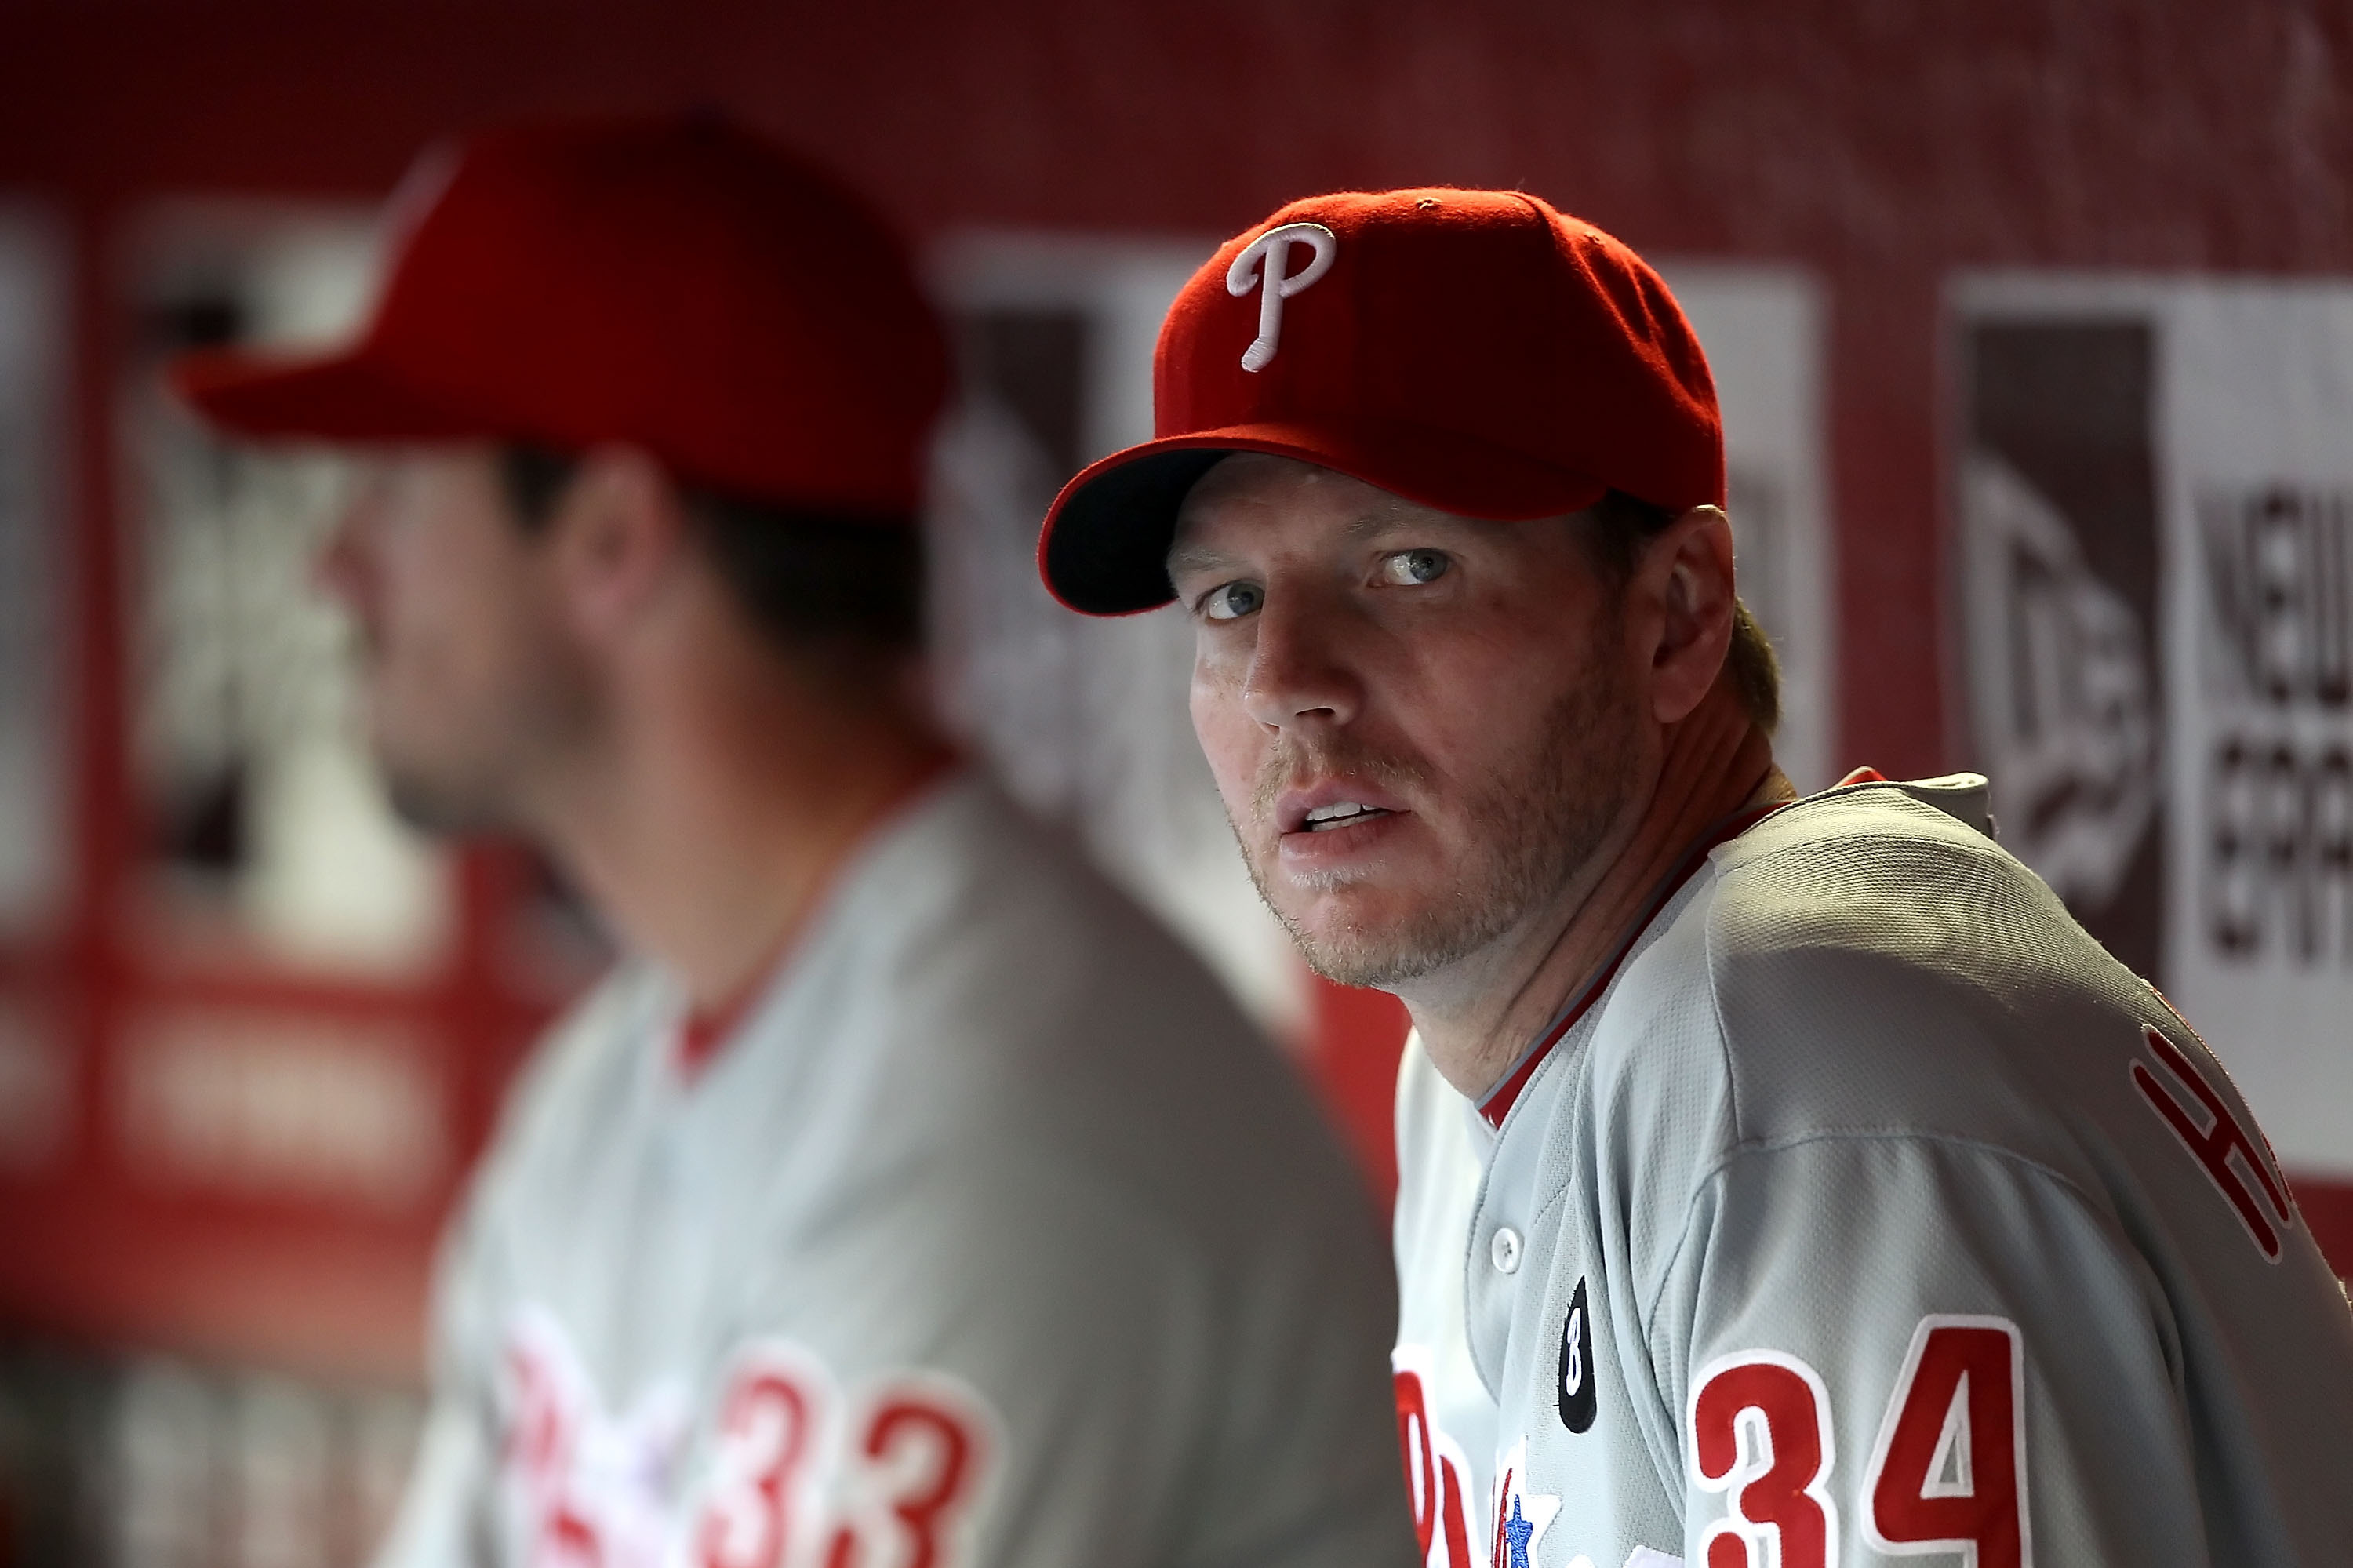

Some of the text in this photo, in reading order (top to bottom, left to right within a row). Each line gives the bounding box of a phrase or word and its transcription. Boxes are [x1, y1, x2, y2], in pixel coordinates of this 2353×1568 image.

[1226, 221, 1337, 373] P
[1565, 1306, 1584, 1397] 8
[1688, 1314, 2033, 1568] 34
[694, 1343, 998, 1568] 33
